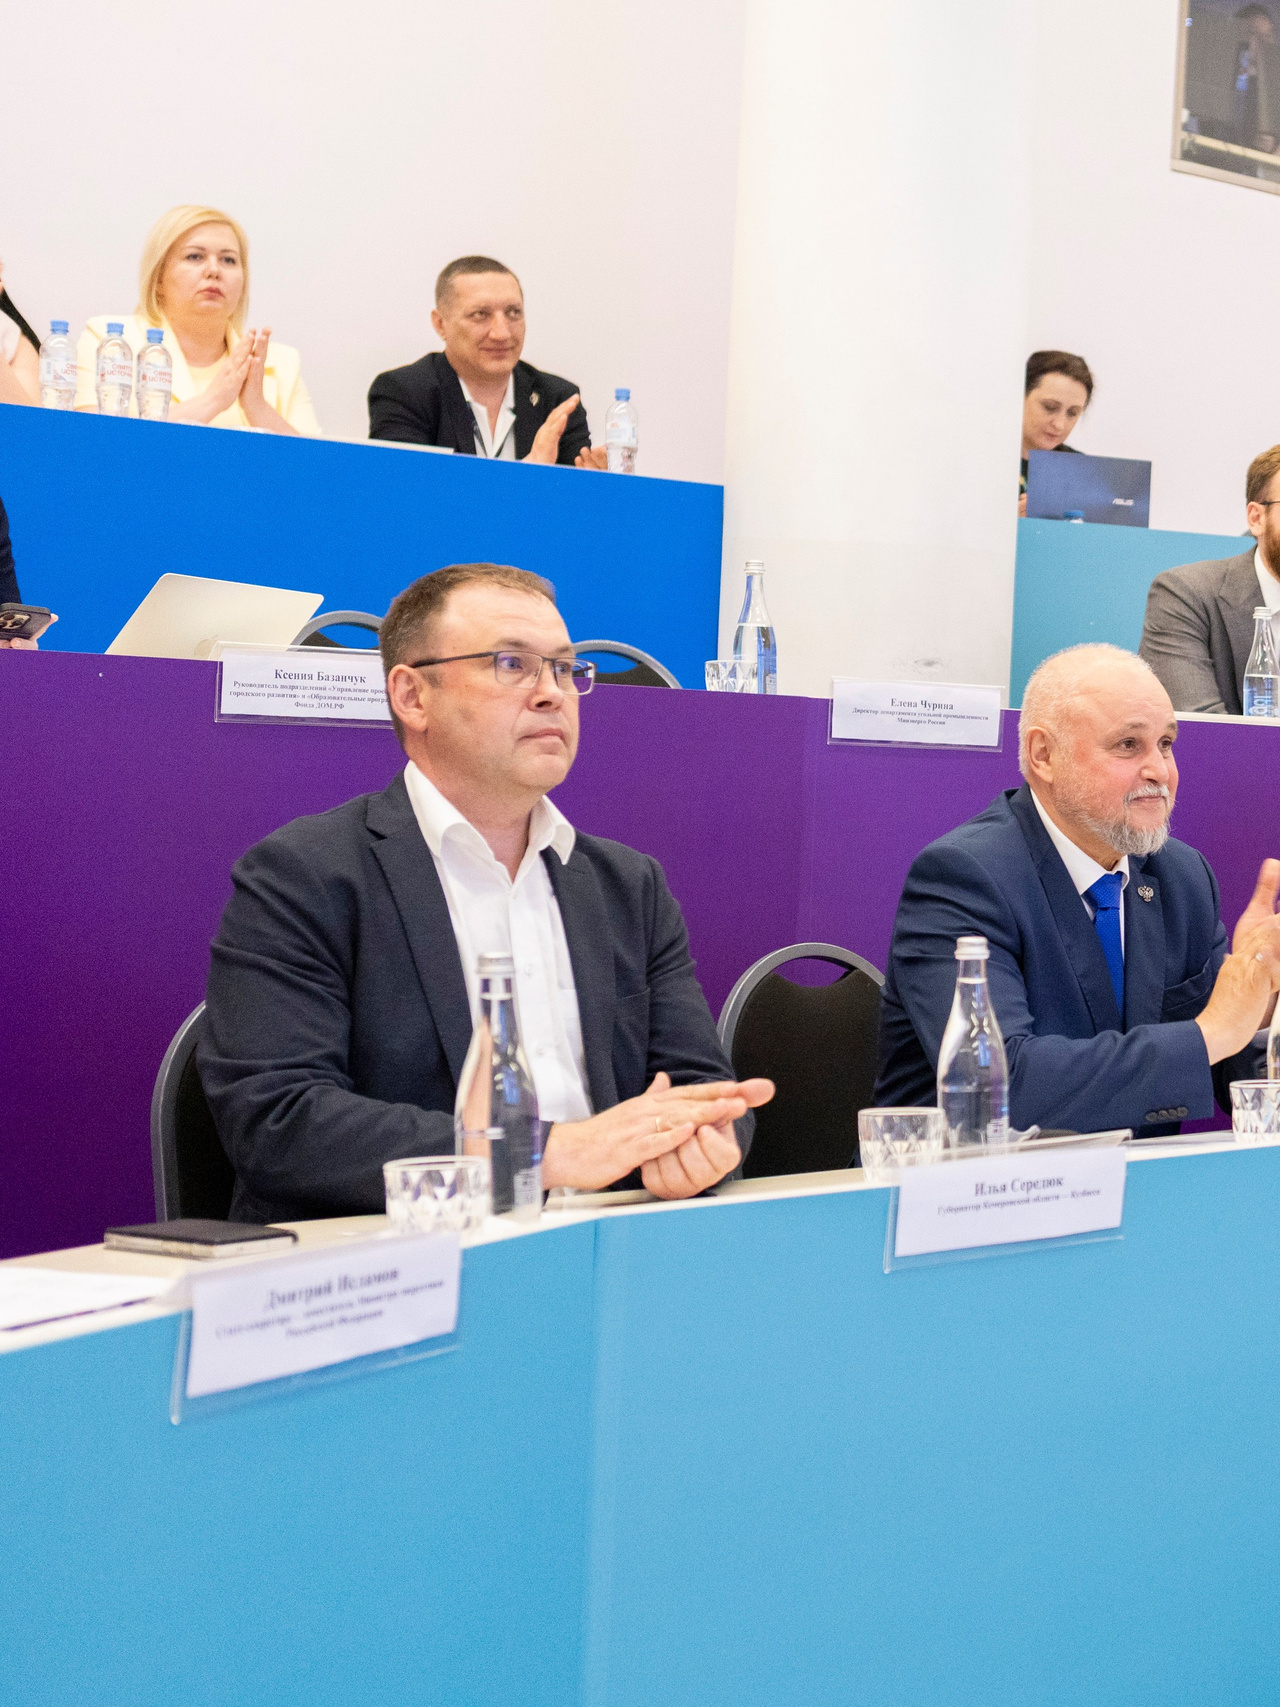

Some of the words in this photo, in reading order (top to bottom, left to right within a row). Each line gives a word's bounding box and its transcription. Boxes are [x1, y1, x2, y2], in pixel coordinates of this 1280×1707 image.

[274, 669, 313, 681] Ксения
[317, 671, 367, 685] Базанчук
[229, 690, 266, 698] городского
[233, 681, 279, 690] Руководитель
[280, 684, 327, 692] подразделений
[328, 685, 369, 694] «Управление
[891, 698, 918, 708] Елена
[920, 700, 954, 711] Чурина
[852, 708, 879, 716] Директор
[880, 710, 917, 718] департамента
[943, 712, 989, 720] промышленности
[897, 717, 927, 725] Минэнерго
[975, 1181, 1007, 1198] Илья
[1011, 1176, 1064, 1194] Середюк
[938, 1202, 982, 1216] Губернатор
[264, 1281, 333, 1311] Дмитрий
[337, 1268, 400, 1293] Исламов
